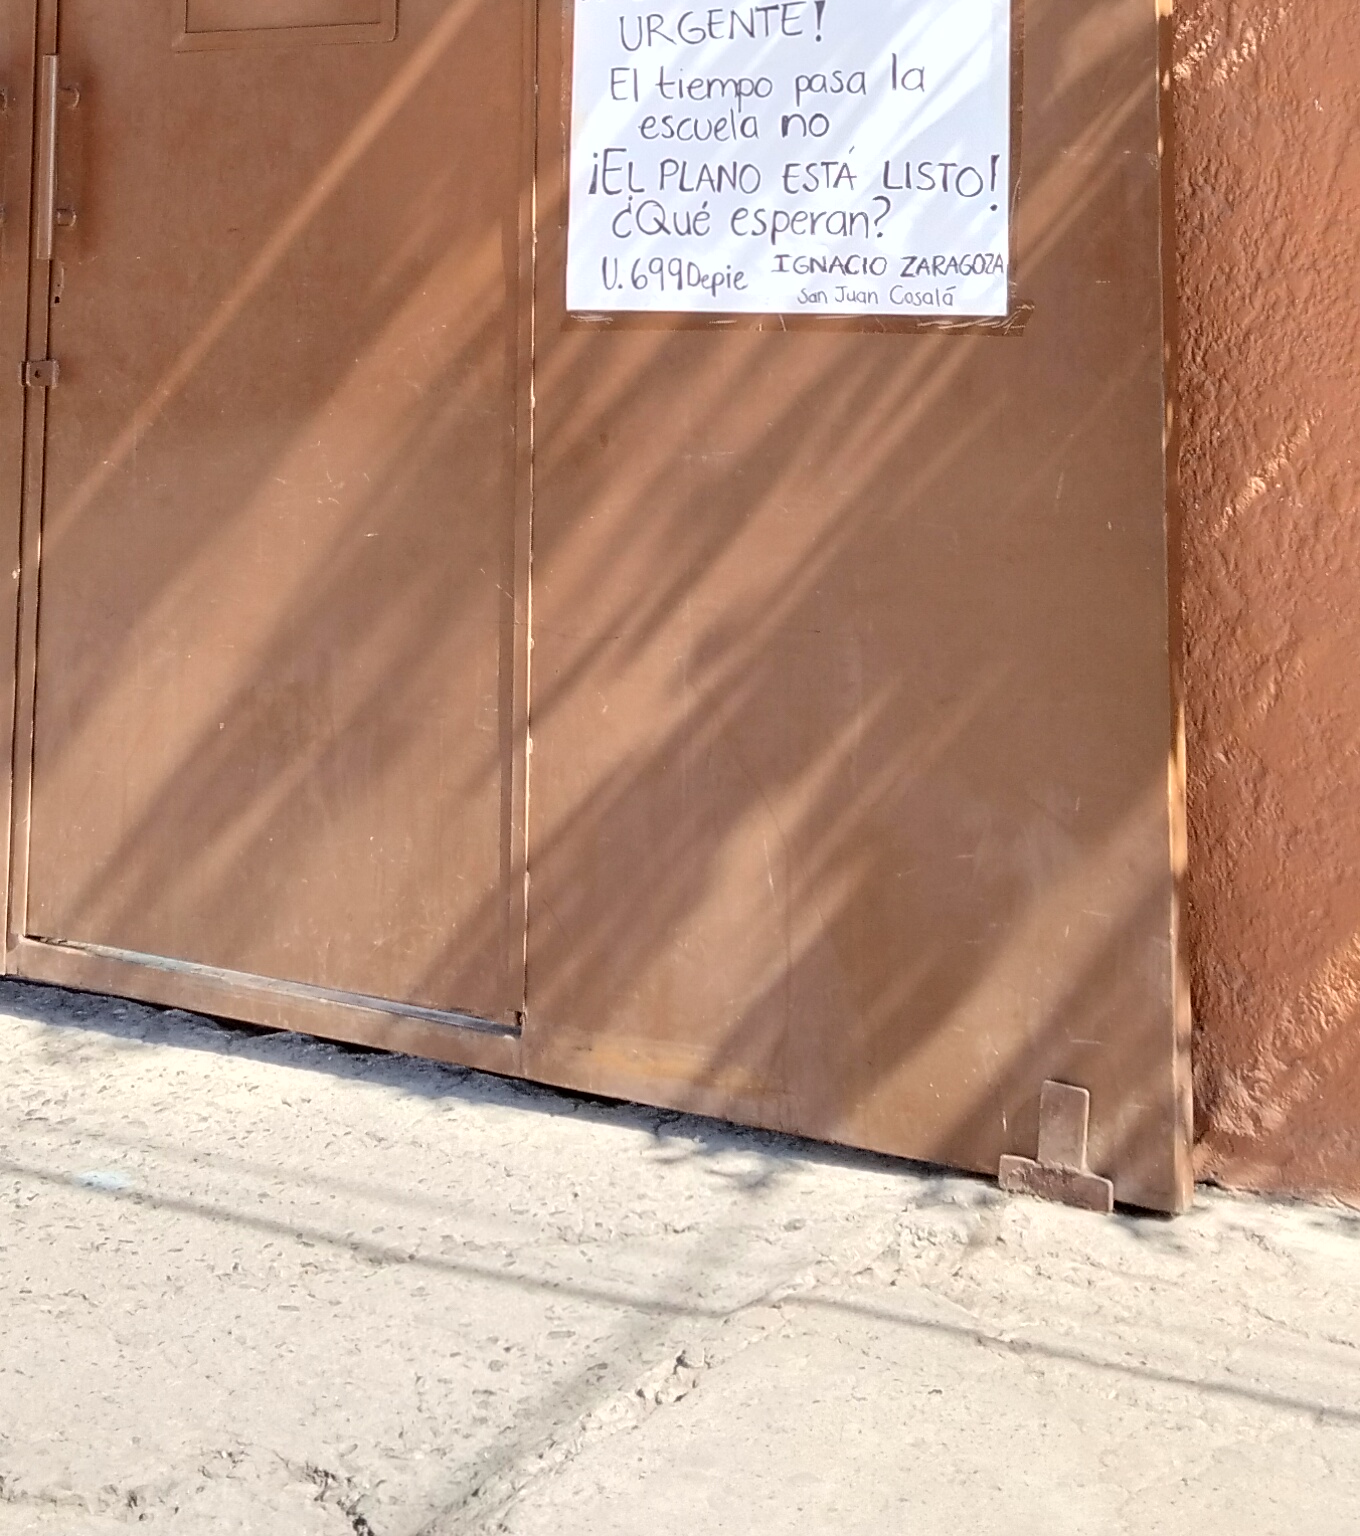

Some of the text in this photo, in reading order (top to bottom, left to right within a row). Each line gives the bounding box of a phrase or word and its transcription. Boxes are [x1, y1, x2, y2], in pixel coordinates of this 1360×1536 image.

[620, 0, 828, 52] URGENTE!
[610, 52, 925, 113] El tiempo pasa la
[639, 109, 830, 142] escuela no
[660, 159, 761, 195] PLANO
[783, 146, 857, 195] ESTÁ
[883, 154, 1001, 212] LISTO!
[612, 195, 892, 245] ¿Qué esperan?
[771, 255, 887, 276] IGNACIO
[900, 252, 1004, 278] ZARAGOZA
[797, 284, 954, 307] San Juan Cosalá
